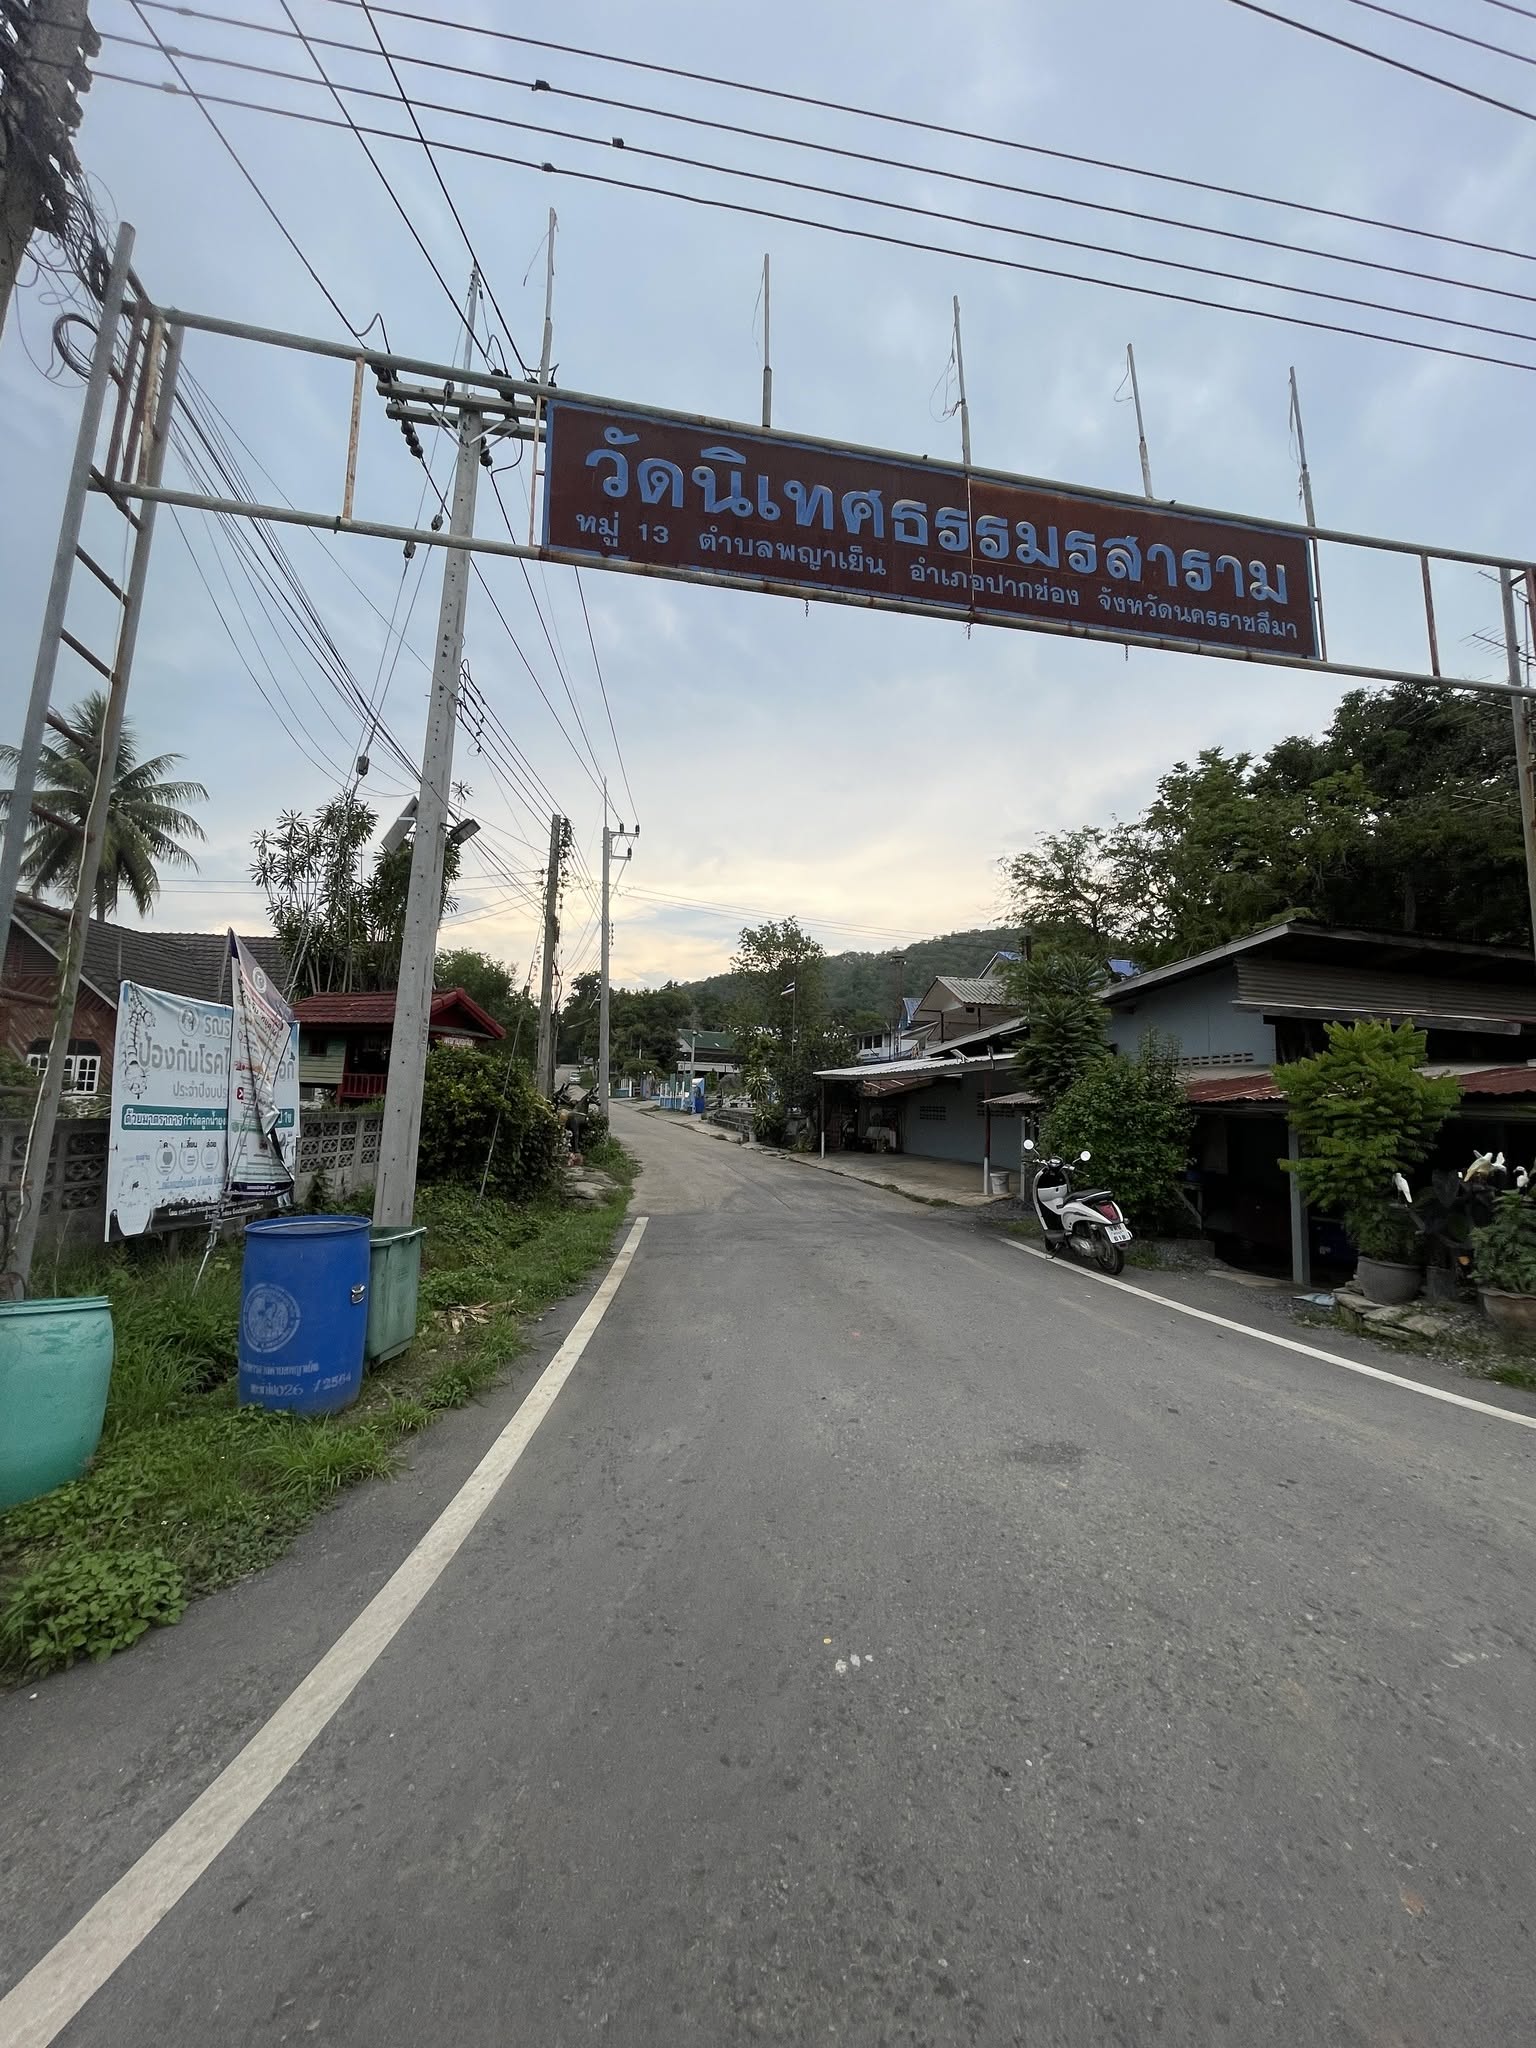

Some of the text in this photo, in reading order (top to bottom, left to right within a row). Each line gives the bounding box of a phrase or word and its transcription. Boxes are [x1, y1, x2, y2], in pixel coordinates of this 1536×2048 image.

[575, 511, 620, 548] หมู่
[638, 523, 670, 544] 13
[699, 525, 888, 576] ตำบลพญาเย็น
[909, 556, 1080, 606] อำเภอปากช่อง
[585, 426, 1289, 605] วัดนิเทศธรรมรสาราม
